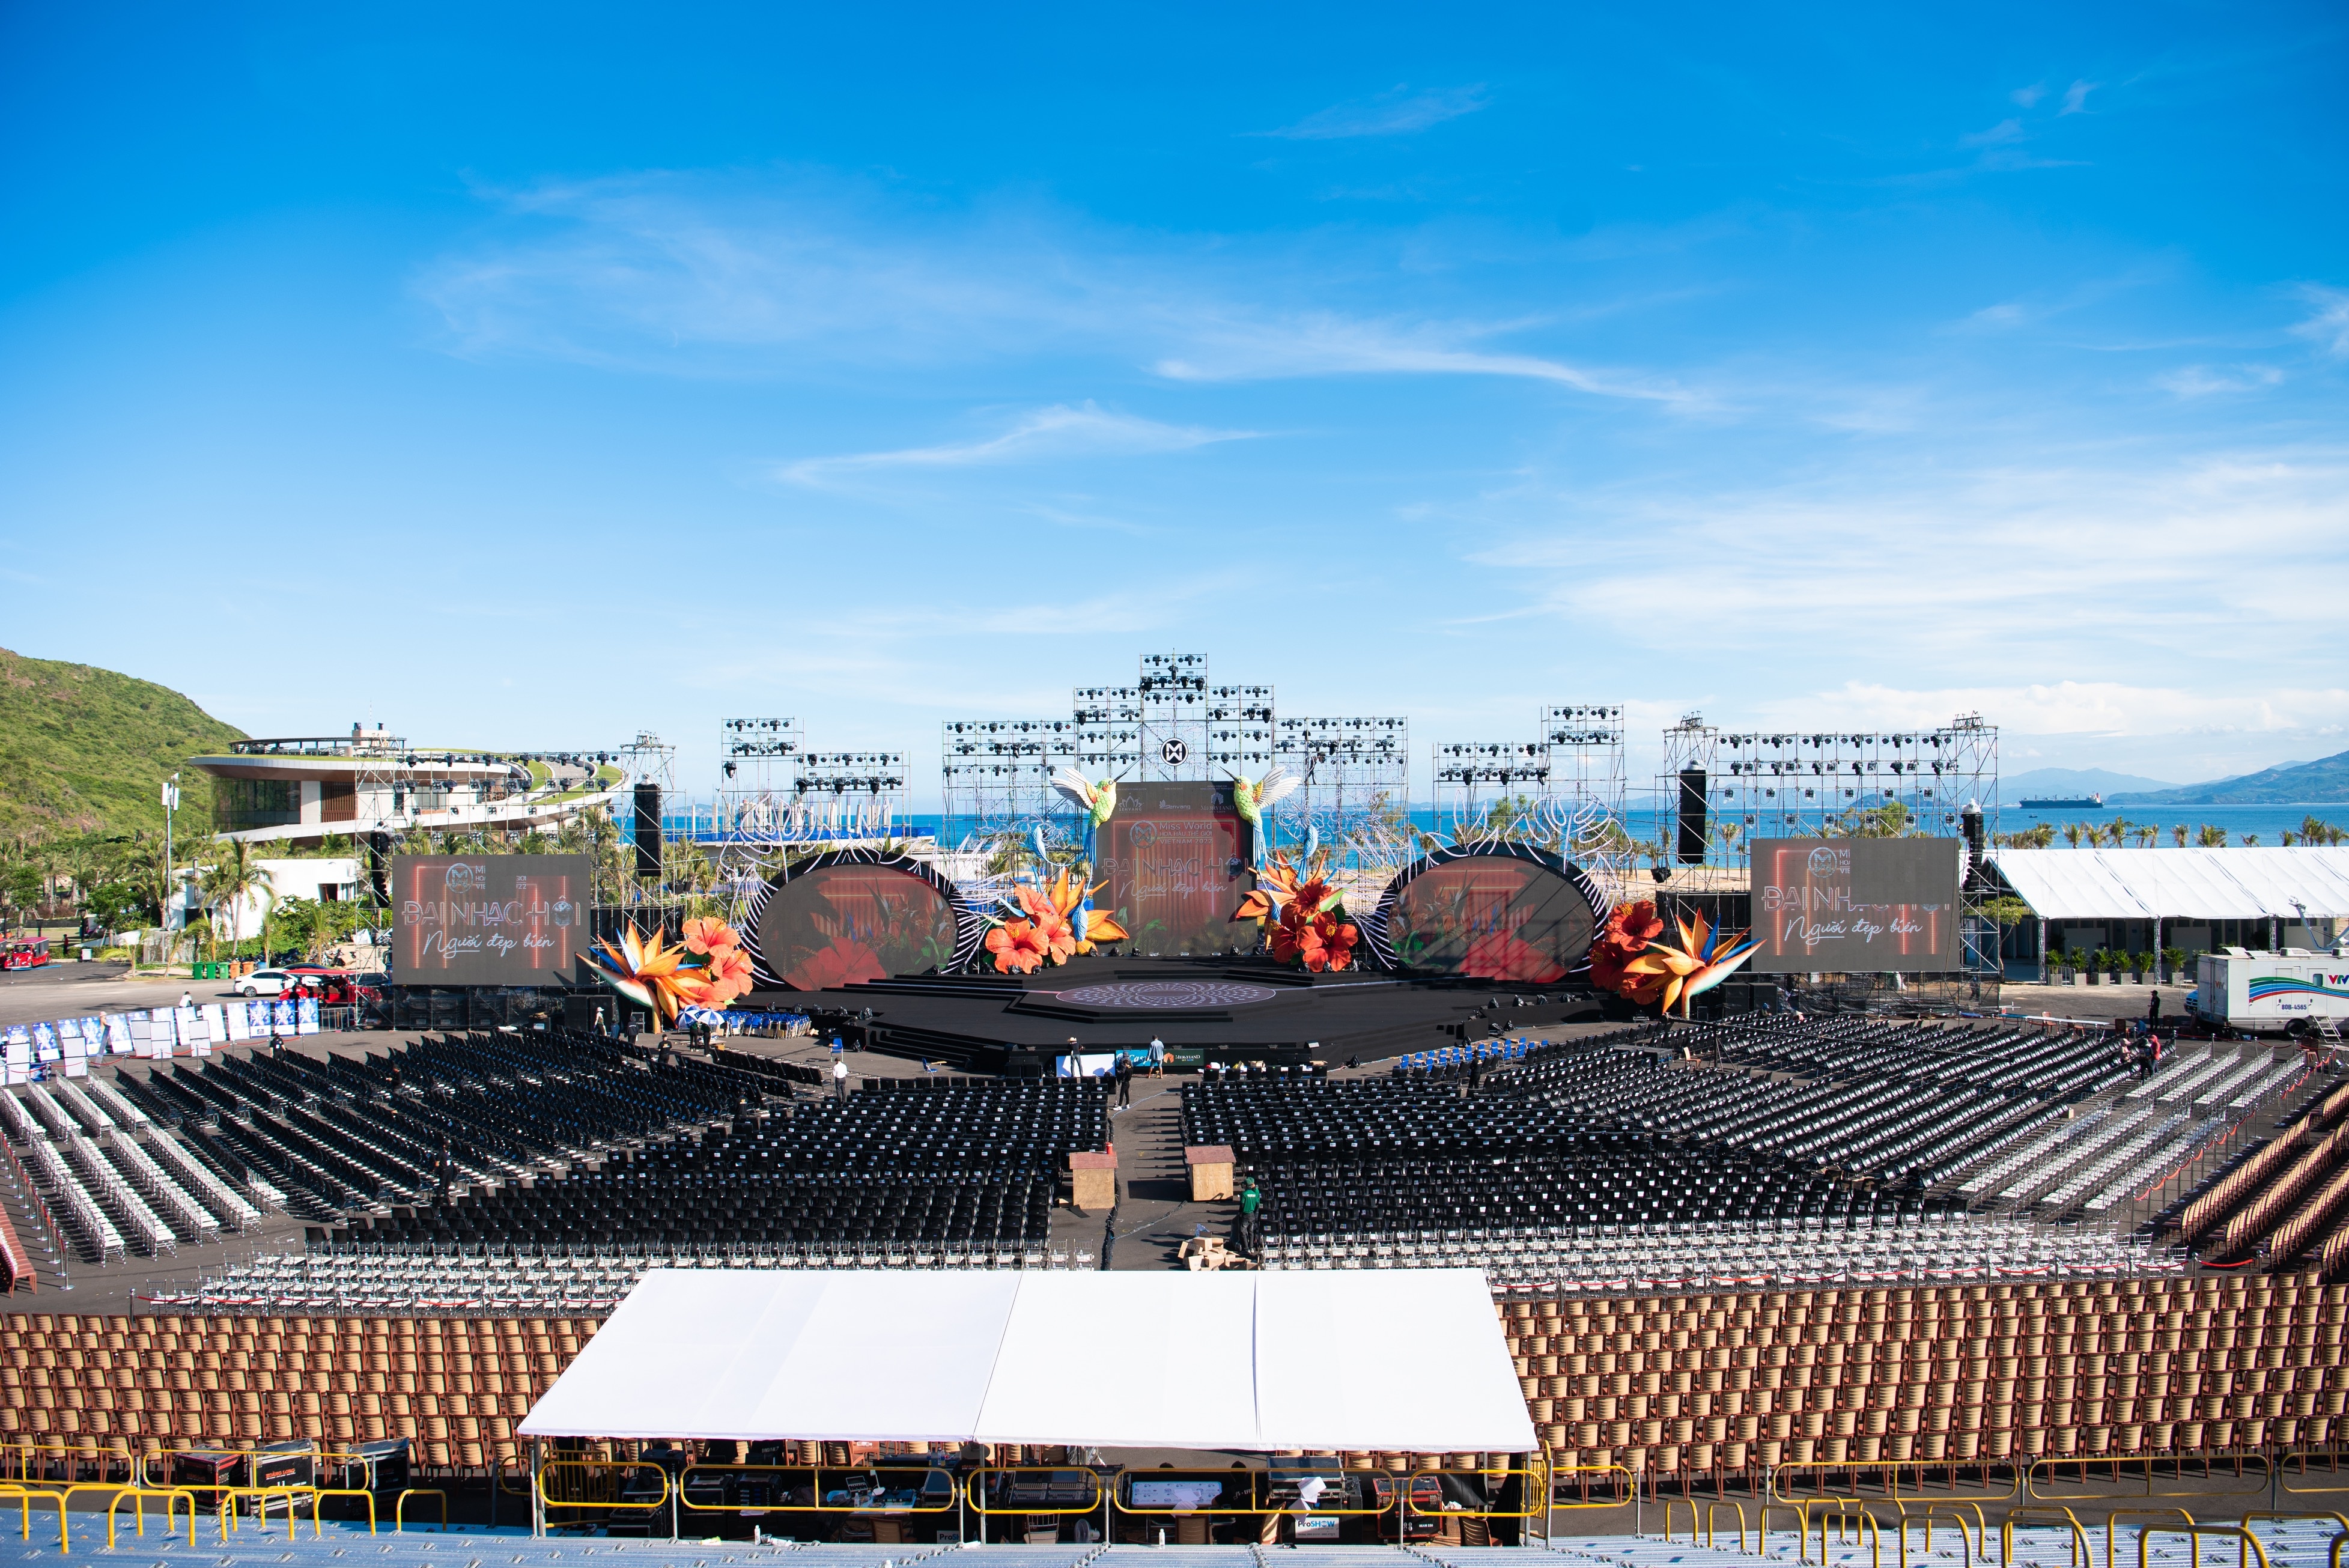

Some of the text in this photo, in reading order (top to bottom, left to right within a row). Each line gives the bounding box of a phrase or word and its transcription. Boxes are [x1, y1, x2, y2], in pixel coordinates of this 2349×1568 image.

[1159, 821, 1212, 830] Miss World
[1102, 858, 1137, 877] ĐẠI
[1142, 857, 1202, 877] NHẠC
[1761, 886, 1807, 911] ĐẠI
[402, 895, 581, 929] ĐẠI NHẠC HỘI
[1851, 918, 1884, 943] đẹp
[486, 932, 518, 958] đẹp
[2328, 974, 2349, 985] VTV
